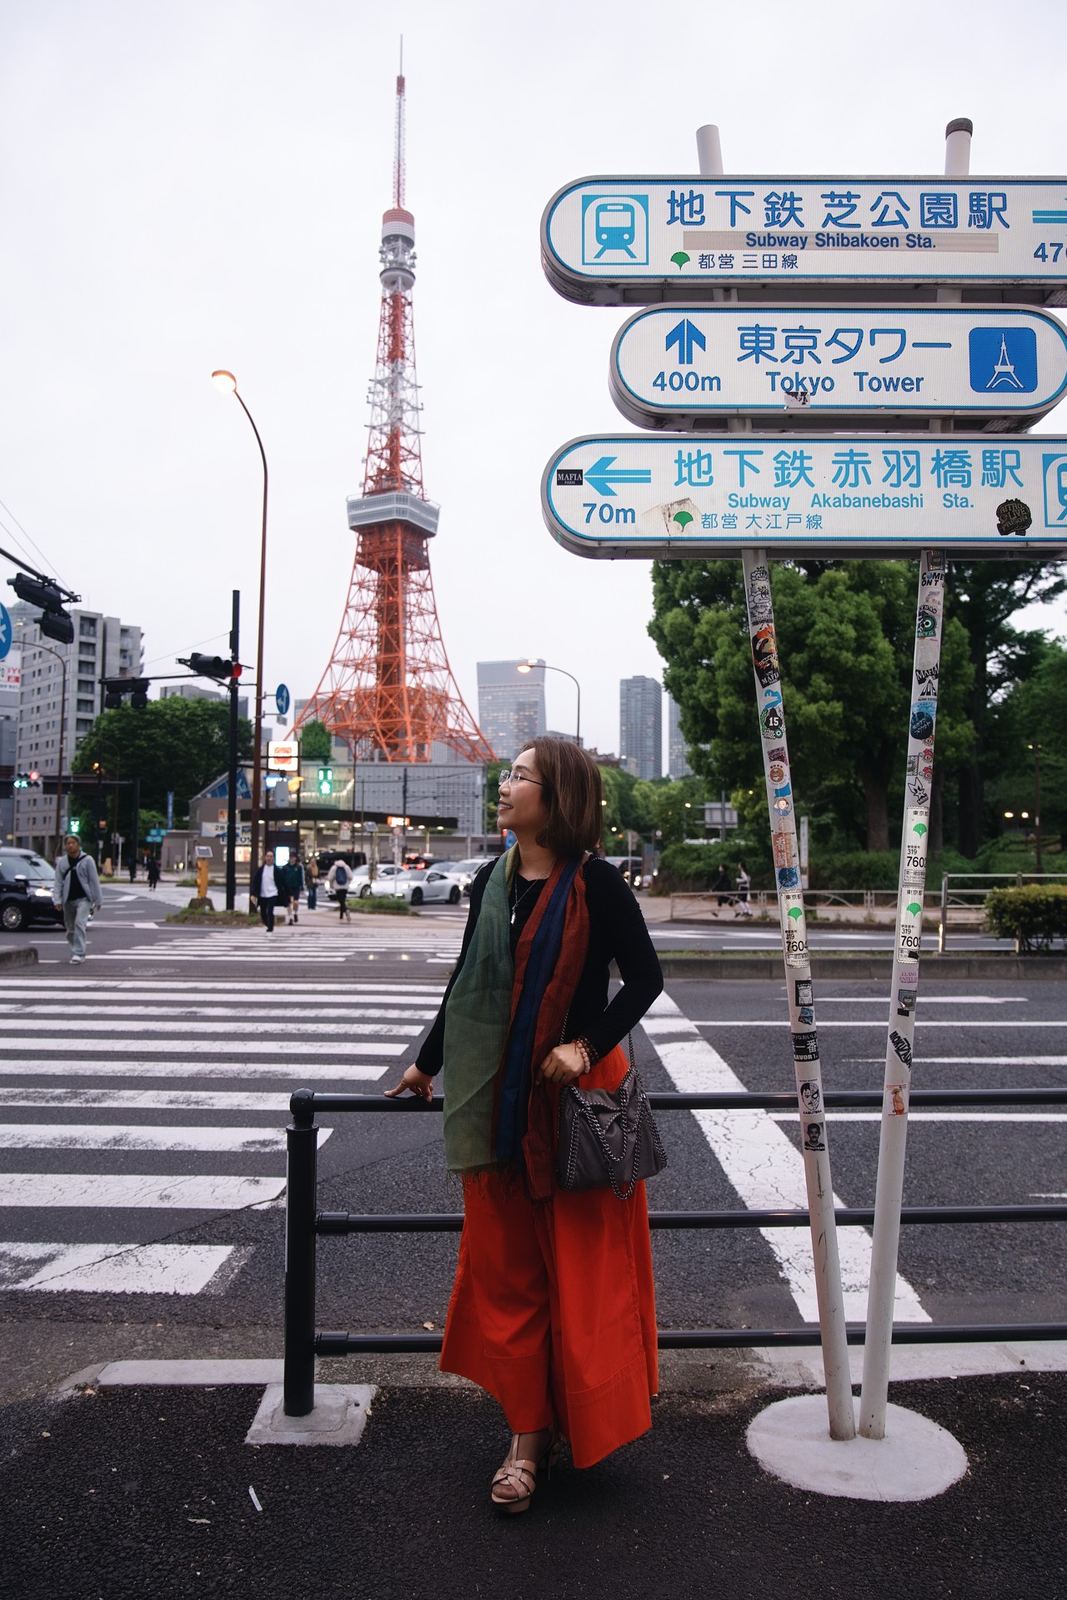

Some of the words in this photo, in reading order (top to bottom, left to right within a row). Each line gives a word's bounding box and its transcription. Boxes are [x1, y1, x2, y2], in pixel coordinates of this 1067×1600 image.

[745, 232, 809, 250] Subway
[814, 232, 900, 249] Shibakoen
[905, 233, 937, 249] Sta.
[698, 253, 735, 270] 都営
[742, 253, 799, 270] 三田線
[1033, 242, 1067, 263] 47
[736, 324, 952, 366] 東京タワー
[652, 371, 722, 392] 400m
[766, 371, 835, 397] Tokyo
[856, 371, 925, 393] Tower
[557, 473, 583, 481] MAFIA
[727, 492, 791, 511] Subway
[811, 492, 924, 509] Akabanebashi
[942, 492, 974, 509] Sta.
[583, 502, 636, 524] 70m
[702, 513, 738, 530] 都営
[746, 513, 823, 530] 大江戸線
[768, 716, 780, 727] 15
